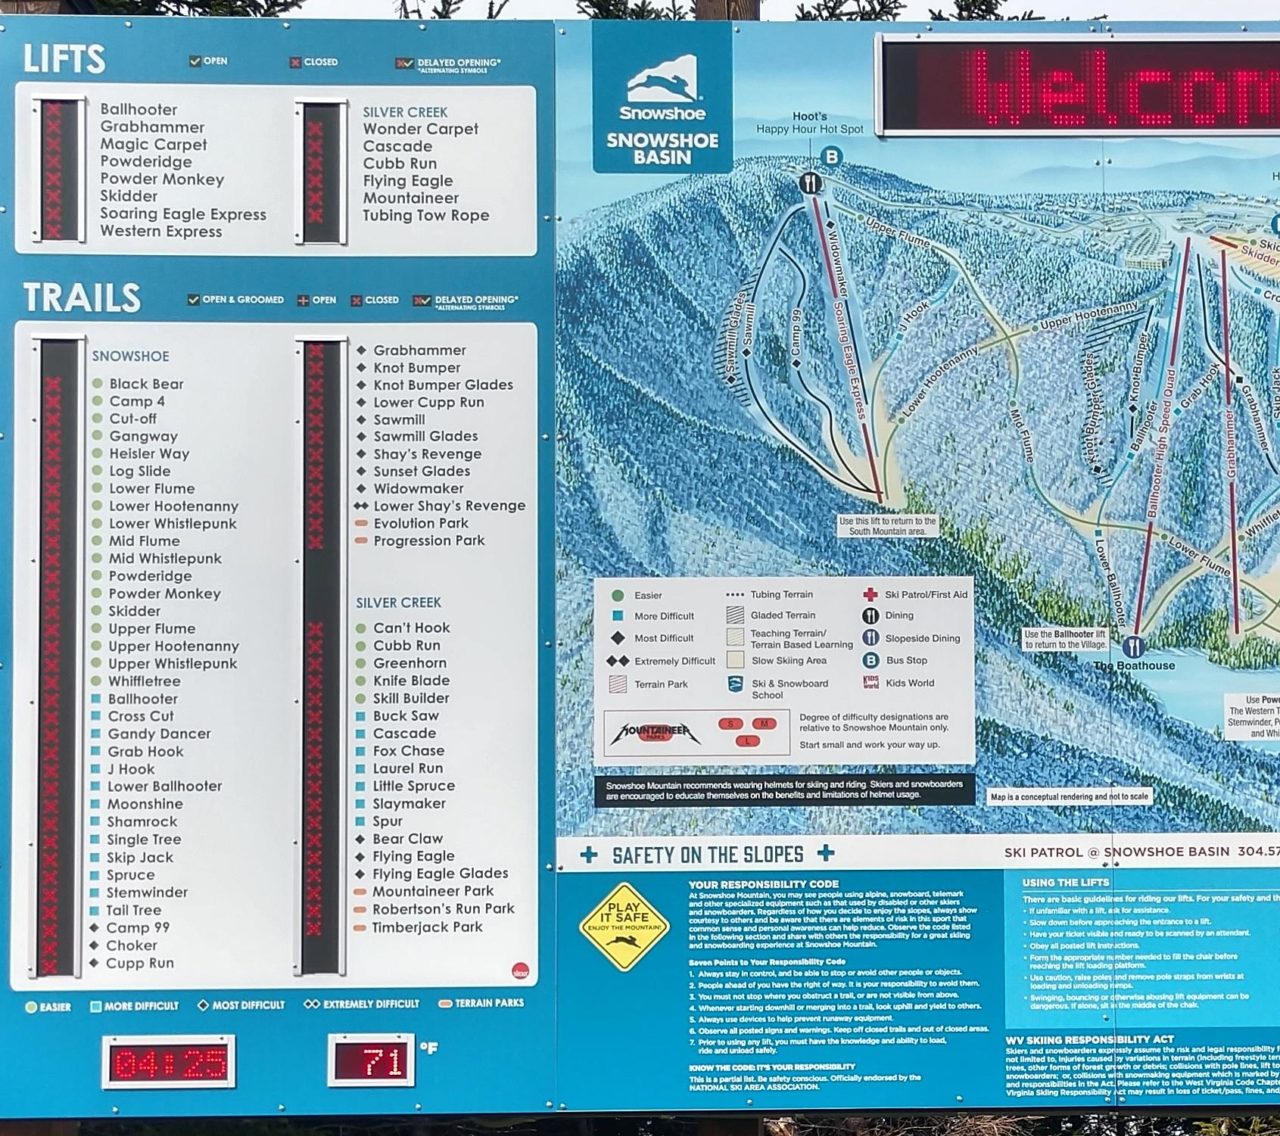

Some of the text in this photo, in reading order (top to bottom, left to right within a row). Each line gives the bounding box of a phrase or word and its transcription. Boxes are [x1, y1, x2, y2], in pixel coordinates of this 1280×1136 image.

[25, 44, 107, 75] LIFTS
[419, 59, 455, 67] DELAYED
[101, 103, 177, 115] Ballhooter
[363, 107, 447, 117] SILVER CREEK
[620, 106, 706, 120] Snowshoe
[793, 112, 827, 121] Hoot's
[101, 120, 204, 133] Grabhammer
[364, 123, 478, 137] Wonder Carpet
[757, 124, 863, 135] Happy Hour Hot Spot
[101, 138, 207, 153] Magic Carpet
[606, 133, 720, 150] SNOWSHOE
[101, 155, 192, 170] Powderidge
[633, 150, 693, 166] BASIN
[101, 172, 224, 188] Powder Monkey
[101, 190, 157, 202] Skidder
[364, 192, 459, 204] Mountaineer
[101, 207, 266, 223] Soaring Eagle Express
[363, 209, 489, 224] Tubing Tow Rope
[101, 225, 222, 240] Western Express
[866, 217, 932, 249] Upper Flume
[828, 230, 849, 298] Widowmaker
[23, 282, 142, 314] TRAILS
[93, 351, 169, 361] SNOWSHOE
[374, 345, 466, 356] Grabhammer
[111, 378, 183, 389] Black Bear
[374, 414, 425, 425] Sawmill
[1241, 385, 1270, 452] Grabhammer
[110, 431, 178, 444] Gangway
[374, 449, 482, 462] Shay's Revenge
[374, 483, 464, 494] Widowmaker
[110, 501, 239, 514] Lower Hootenanny
[375, 517, 468, 529] Evolution Park
[751, 591, 780, 600] Tubing
[357, 597, 441, 608] SILVER CREEK
[886, 611, 913, 621] Dining
[374, 622, 450, 633] Can't Hook
[374, 657, 446, 668] Greenhorn
[635, 657, 715, 667] Extremely Difficult
[777, 657, 804, 666] Skiing
[907, 656, 927, 665] Stop
[109, 676, 180, 686] Whiffletree
[108, 763, 155, 775] J Hook
[374, 780, 455, 793] Little Spruce
[108, 816, 177, 827] Shamrock
[613, 846, 803, 864] SAFETY ON THE SLOPES
[1005, 848, 1025, 857] SKI
[1031, 848, 1083, 857] PATROL
[1088, 850, 1099, 859] @
[1105, 844, 1184, 859] SNOWSHOE
[1189, 847, 1229, 856] BASIN
[689, 879, 839, 889] YOUR RESPONSIBILITY CODE
[1023, 879, 1055, 887] USING
[107, 887, 188, 898] Stemwinder
[373, 903, 515, 915] Robertson's Run Park
[607, 902, 641, 913] PLAY
[601, 913, 648, 922] IT SAFE
[107, 922, 169, 935] Camp 99
[40, 1002, 72, 1012] EASIER
[104, 1001, 179, 1012] MORE DIFFICULT
[455, 998, 525, 1009] TERRAIN PARKS
[114, 1049, 227, 1080] 04:25
[363, 1048, 403, 1077] 71
